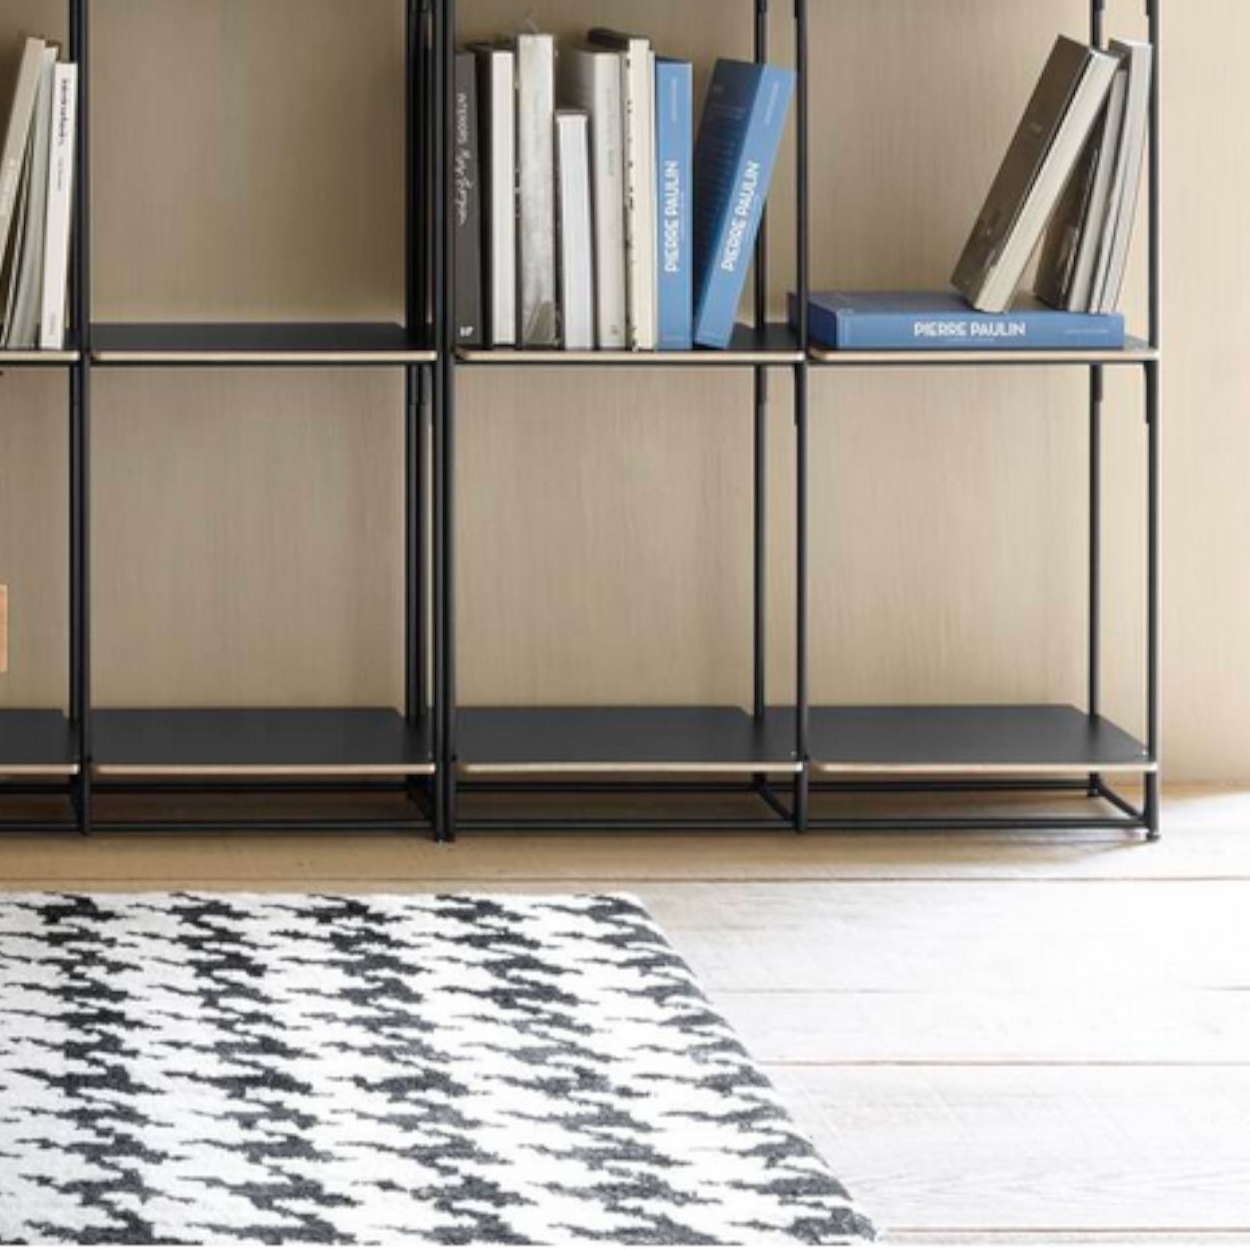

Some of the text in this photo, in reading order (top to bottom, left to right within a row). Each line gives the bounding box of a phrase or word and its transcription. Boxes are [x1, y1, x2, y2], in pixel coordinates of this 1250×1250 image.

[664, 161, 679, 272] PIERRE PAULIN
[720, 160, 761, 272] PIERRE PAULIN
[913, 321, 1026, 337] PIERRE PAULIN
